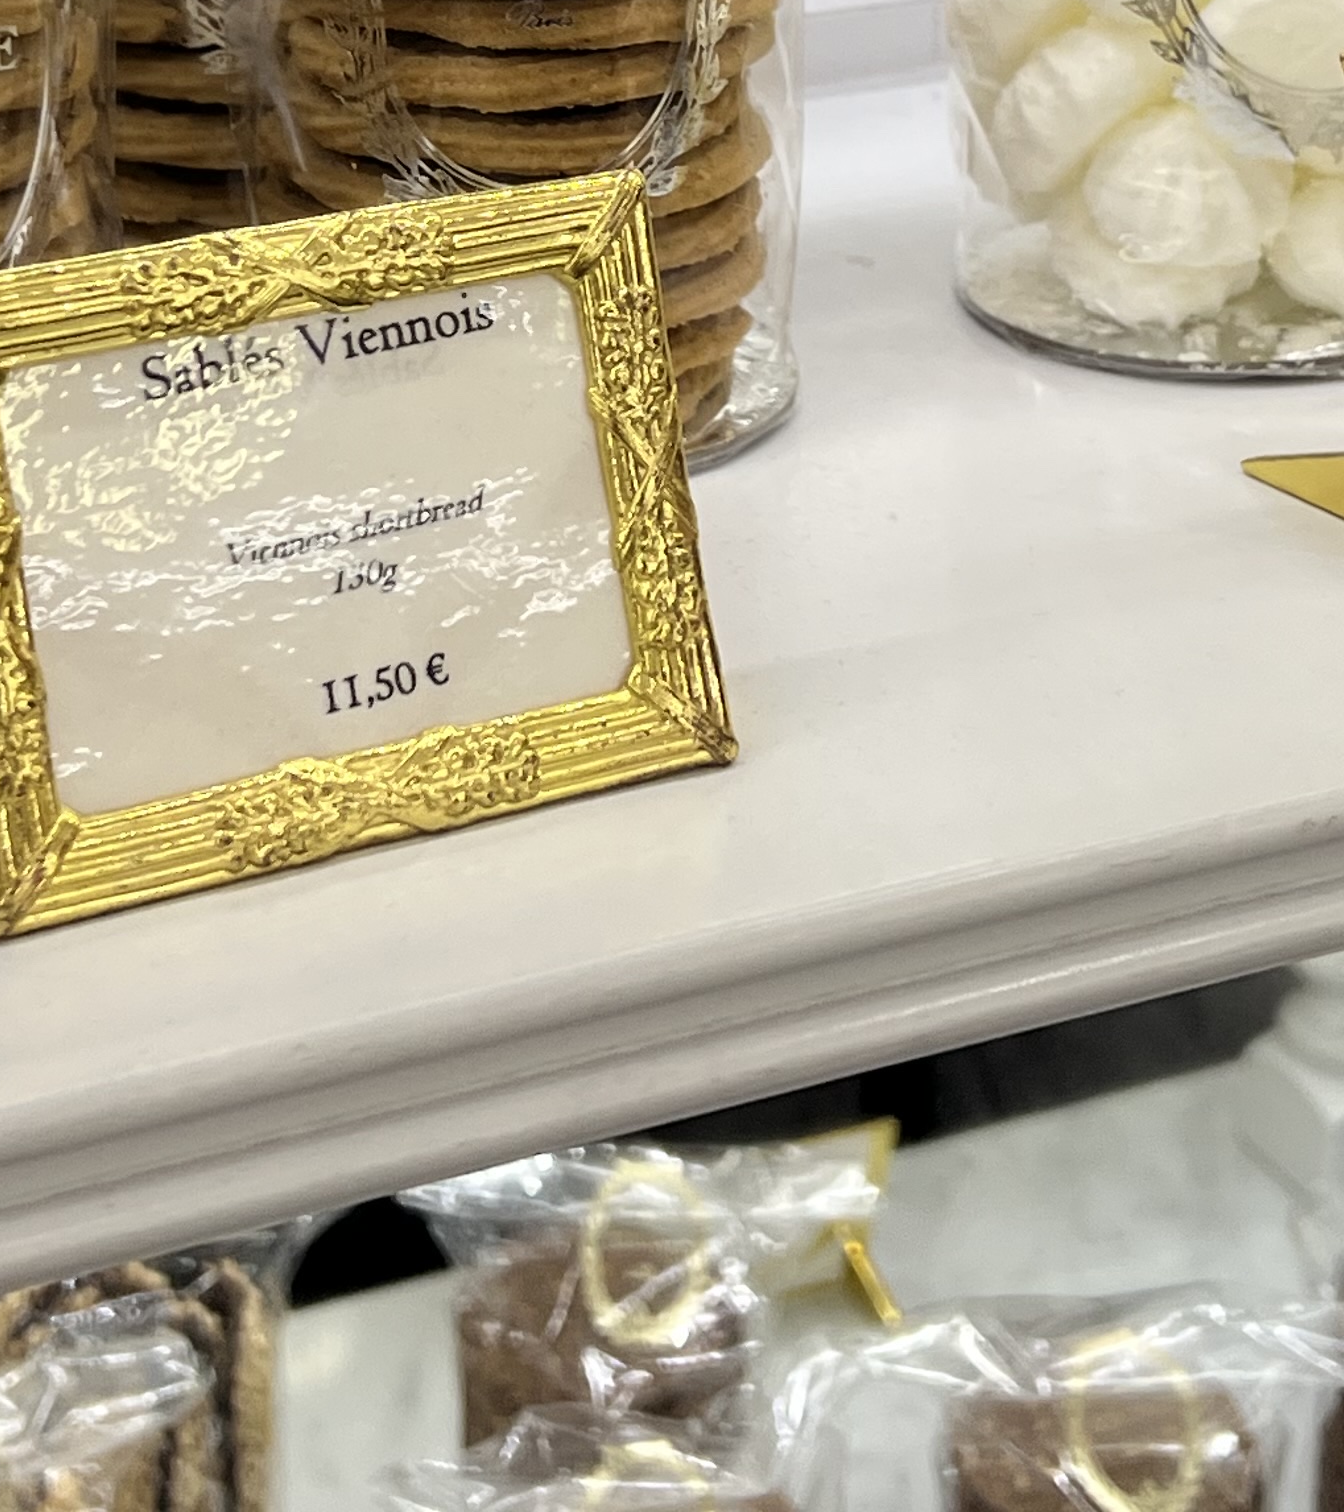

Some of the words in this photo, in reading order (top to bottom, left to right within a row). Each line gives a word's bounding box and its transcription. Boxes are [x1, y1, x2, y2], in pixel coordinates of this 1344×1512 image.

[140, 334, 285, 402] Sablés
[295, 291, 495, 366] Viennois
[321, 660, 417, 716] 11,50
[425, 651, 451, 687] €
